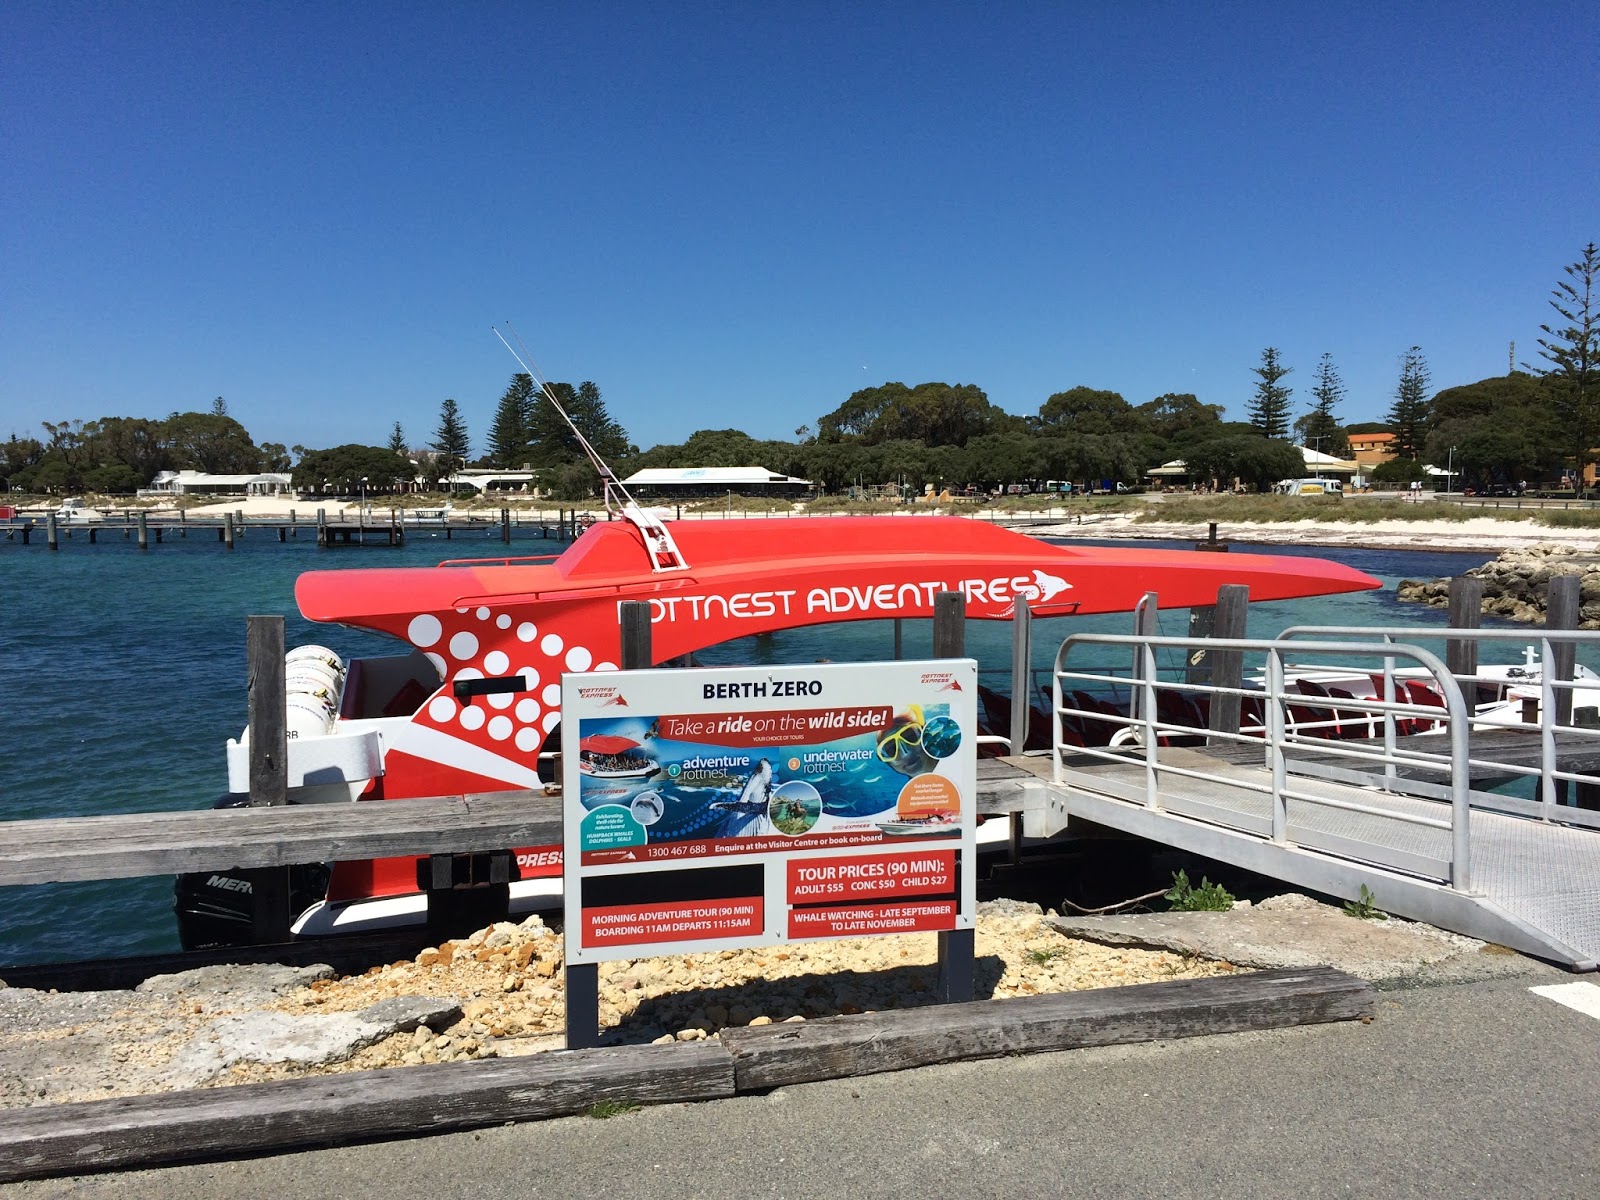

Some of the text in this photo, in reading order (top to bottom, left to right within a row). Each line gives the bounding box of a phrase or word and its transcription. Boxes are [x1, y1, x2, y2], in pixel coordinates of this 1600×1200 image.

[617, 590, 796, 624] OTTNEST
[703, 680, 823, 699] BERTH ZERO
[668, 710, 888, 736] Take a ride on the wild side!
[683, 755, 750, 769] adventure
[804, 748, 874, 762] underwater
[683, 767, 728, 780] rottnest
[804, 761, 846, 774] rottnest
[647, 845, 707, 858] 1300 467 688
[715, 843, 744, 853] Enquire
[754, 841, 767, 850] the
[768, 840, 792, 849] Visitor
[794, 838, 818, 847] Centre
[820, 838, 828, 846] or
[829, 836, 849, 845] book
[849, 834, 883, 843] on-board
[798, 859, 945, 881] TOUR PRICES (90 MIN):
[206, 875, 253, 894] MER
[795, 875, 947, 895] ADULT $55 CONC $50 CHILD $27
[592, 905, 754, 925] MORNING ADVENTURE TOUR (90 MIN)
[794, 912, 826, 922] WHALE
[827, 909, 874, 921] WATCHING
[880, 908, 900, 918] LATE
[901, 905, 951, 916] SEPTEMBER
[595, 918, 751, 937] BOARDING 11AM DEPARTS 11:15AM
[831, 918, 915, 931] TO LATE NOVEMBER
